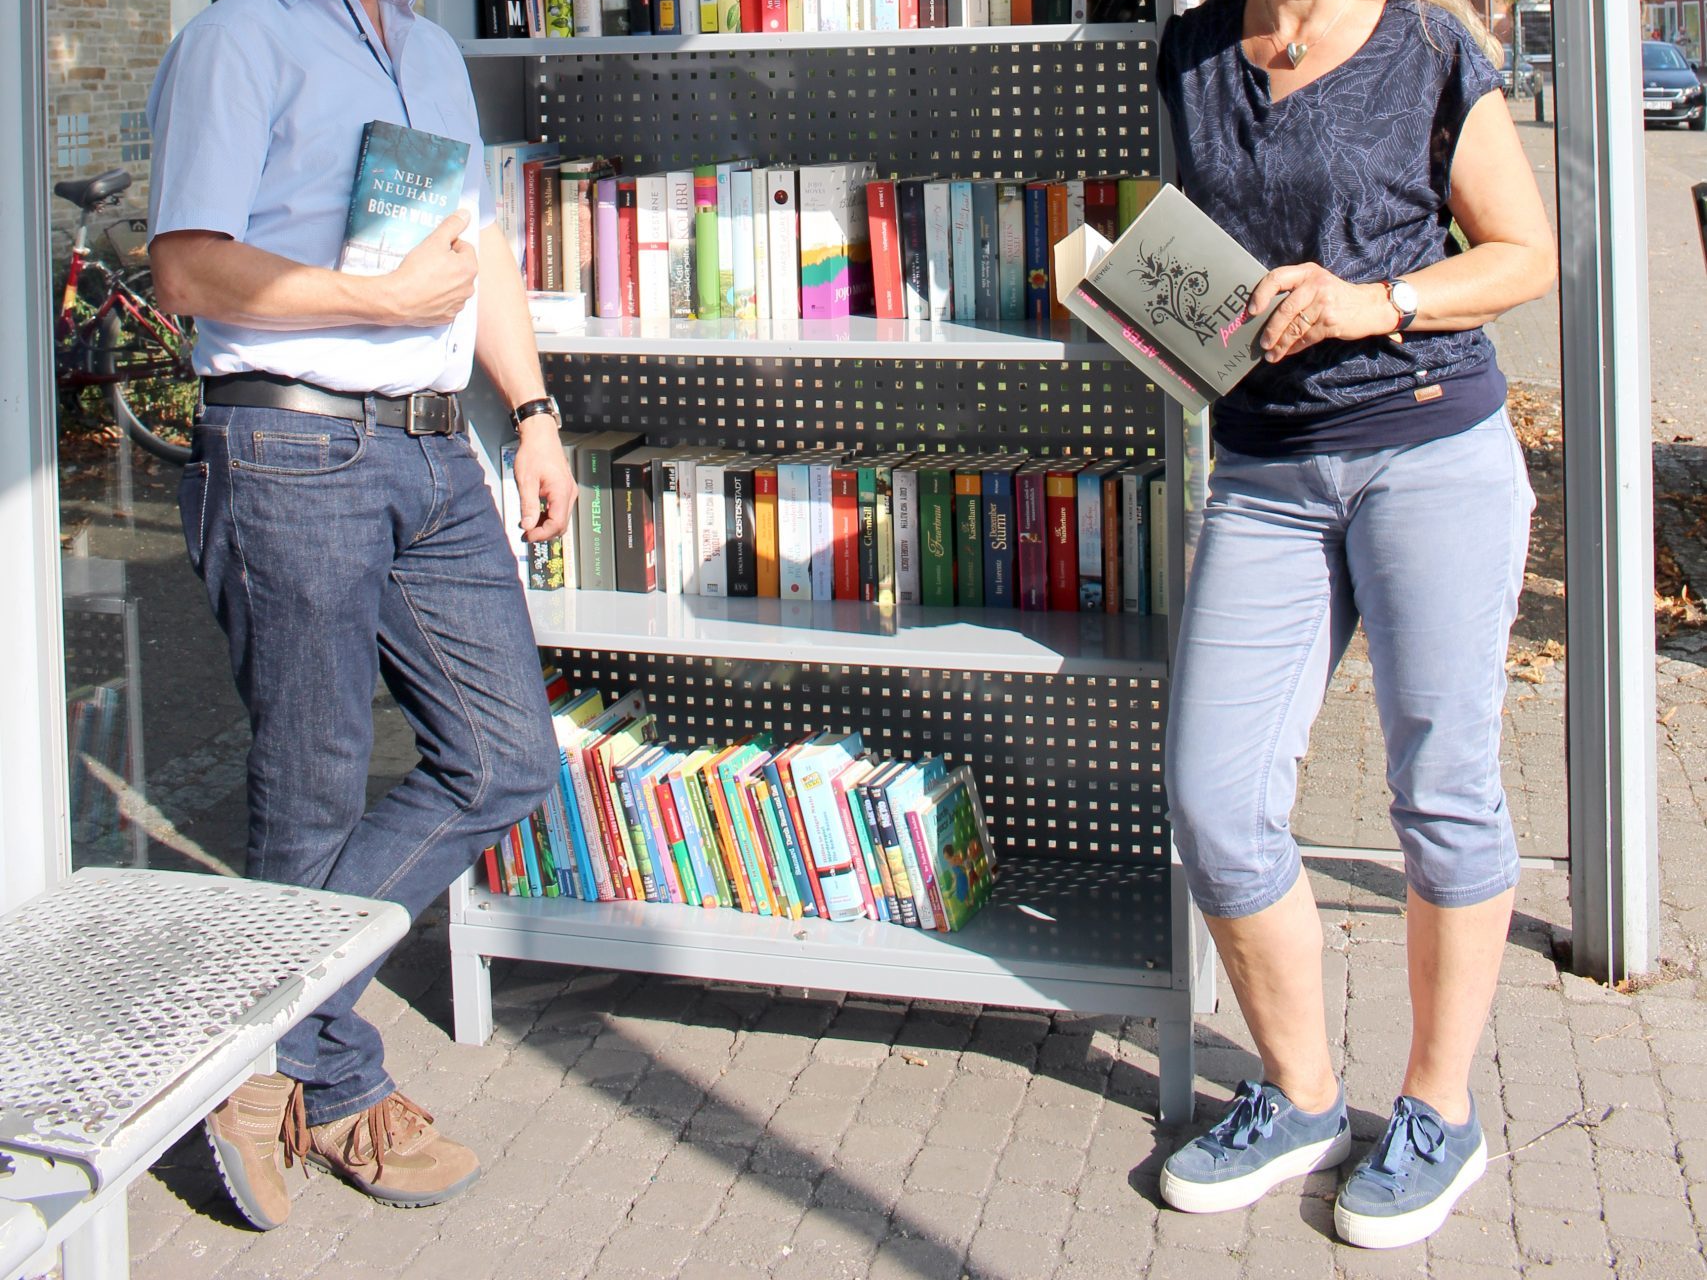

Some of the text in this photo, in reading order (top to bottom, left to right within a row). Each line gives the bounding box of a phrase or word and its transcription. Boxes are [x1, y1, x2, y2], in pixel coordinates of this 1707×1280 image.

[373, 178, 448, 208] NEUHAUS
[393, 169, 433, 189] NELE
[527, 169, 535, 195] ZURÜCK
[367, 198, 407, 220] BÖSER
[544, 177, 553, 227] Sarahs Schlüssel
[676, 182, 690, 240] KOLIBRI
[528, 217, 536, 233] PFAD
[881, 222, 889, 252] Vollendung
[675, 264, 684, 284] Kati
[683, 247, 692, 302] Hiekkapelto
[1092, 263, 1111, 285] HEYNE
[1194, 283, 1253, 347] AFTER
[1120, 324, 1160, 360] AFTER
[1216, 342, 1253, 382] ANNA
[1177, 374, 1199, 395] ANNA
[704, 478, 714, 494] CODY
[899, 487, 908, 501] CODY
[591, 500, 602, 534] AFTER
[734, 476, 744, 539] GEISTERSTADT
[968, 499, 977, 541] Kastellanin
[988, 502, 997, 538] Dezember
[863, 506, 873, 547] Glennkill
[991, 513, 1007, 550] Sturm
[1059, 507, 1067, 544] Wanderhure
[995, 559, 1003, 583] Lorentz
[782, 815, 794, 836] Durch
